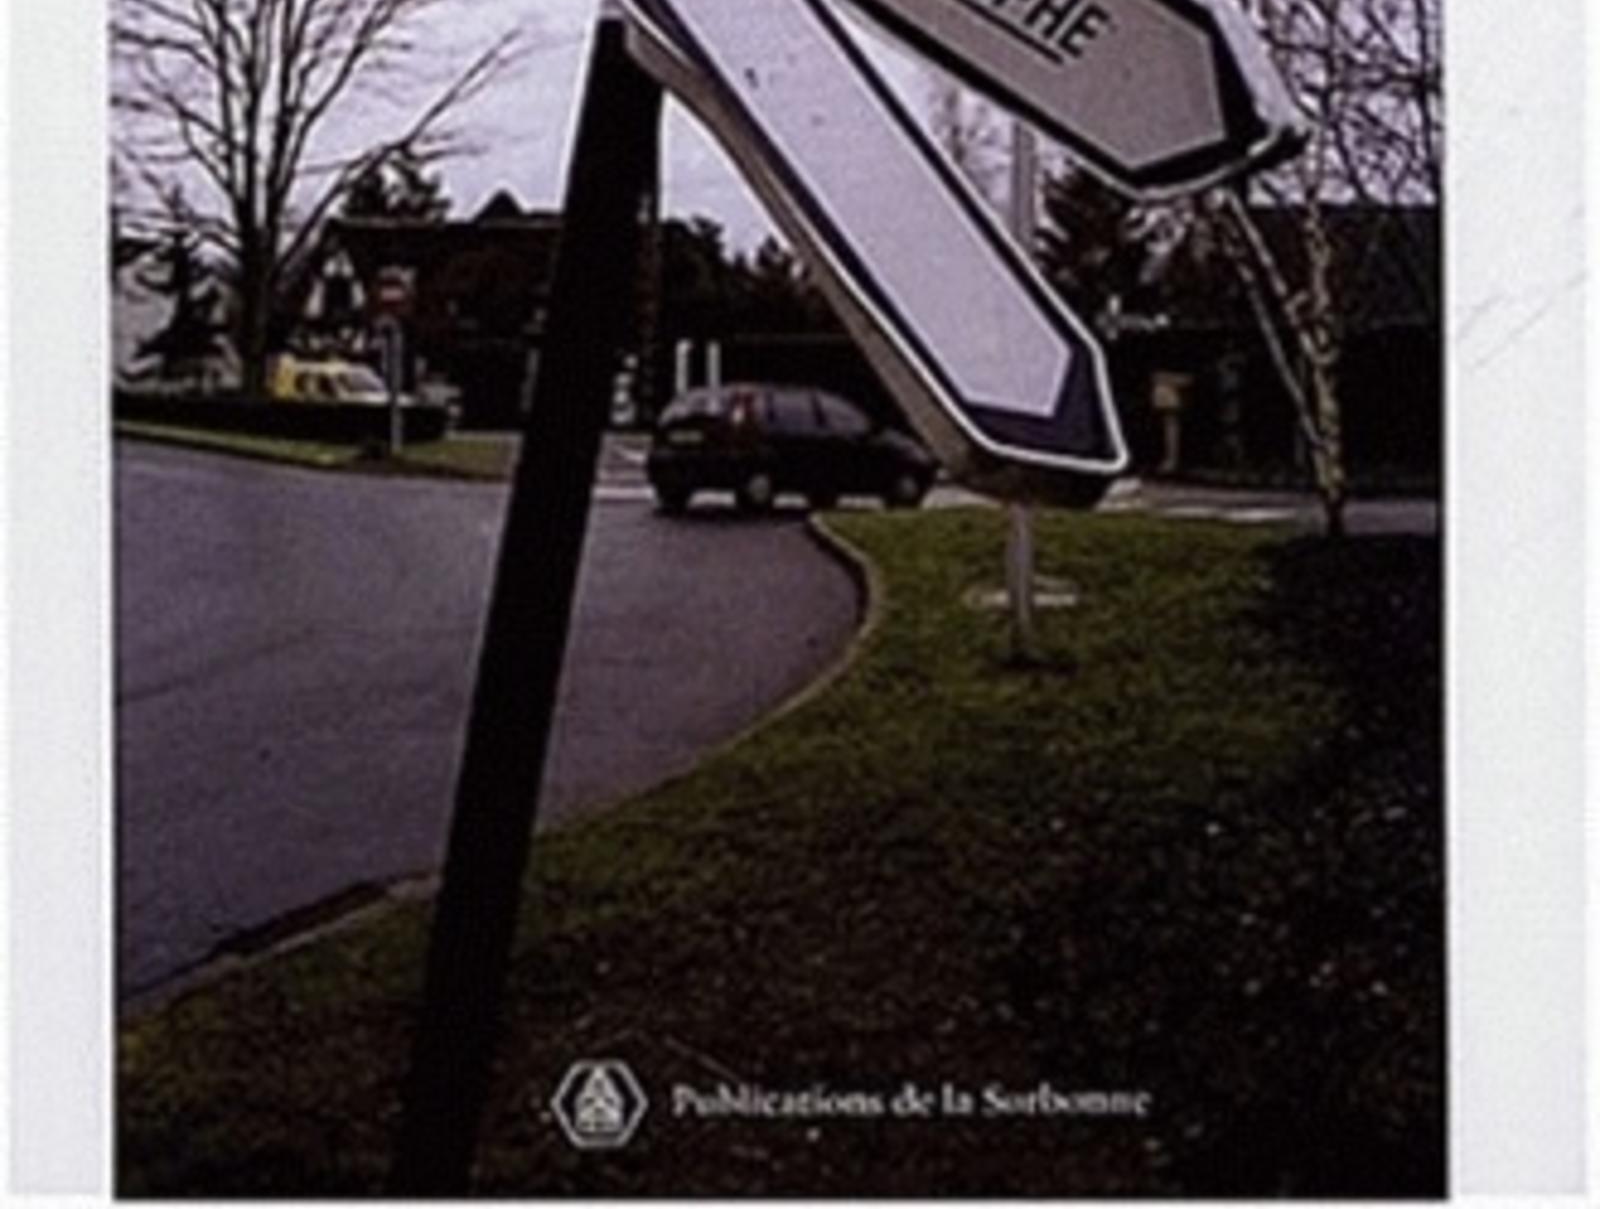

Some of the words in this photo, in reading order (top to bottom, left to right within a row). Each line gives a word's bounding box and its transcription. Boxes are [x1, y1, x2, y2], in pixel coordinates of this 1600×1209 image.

[671, 1082, 885, 1117] Publications
[892, 1082, 934, 1117] de
[941, 1082, 974, 1116] la
[982, 1082, 1152, 1117] Sorbonne
